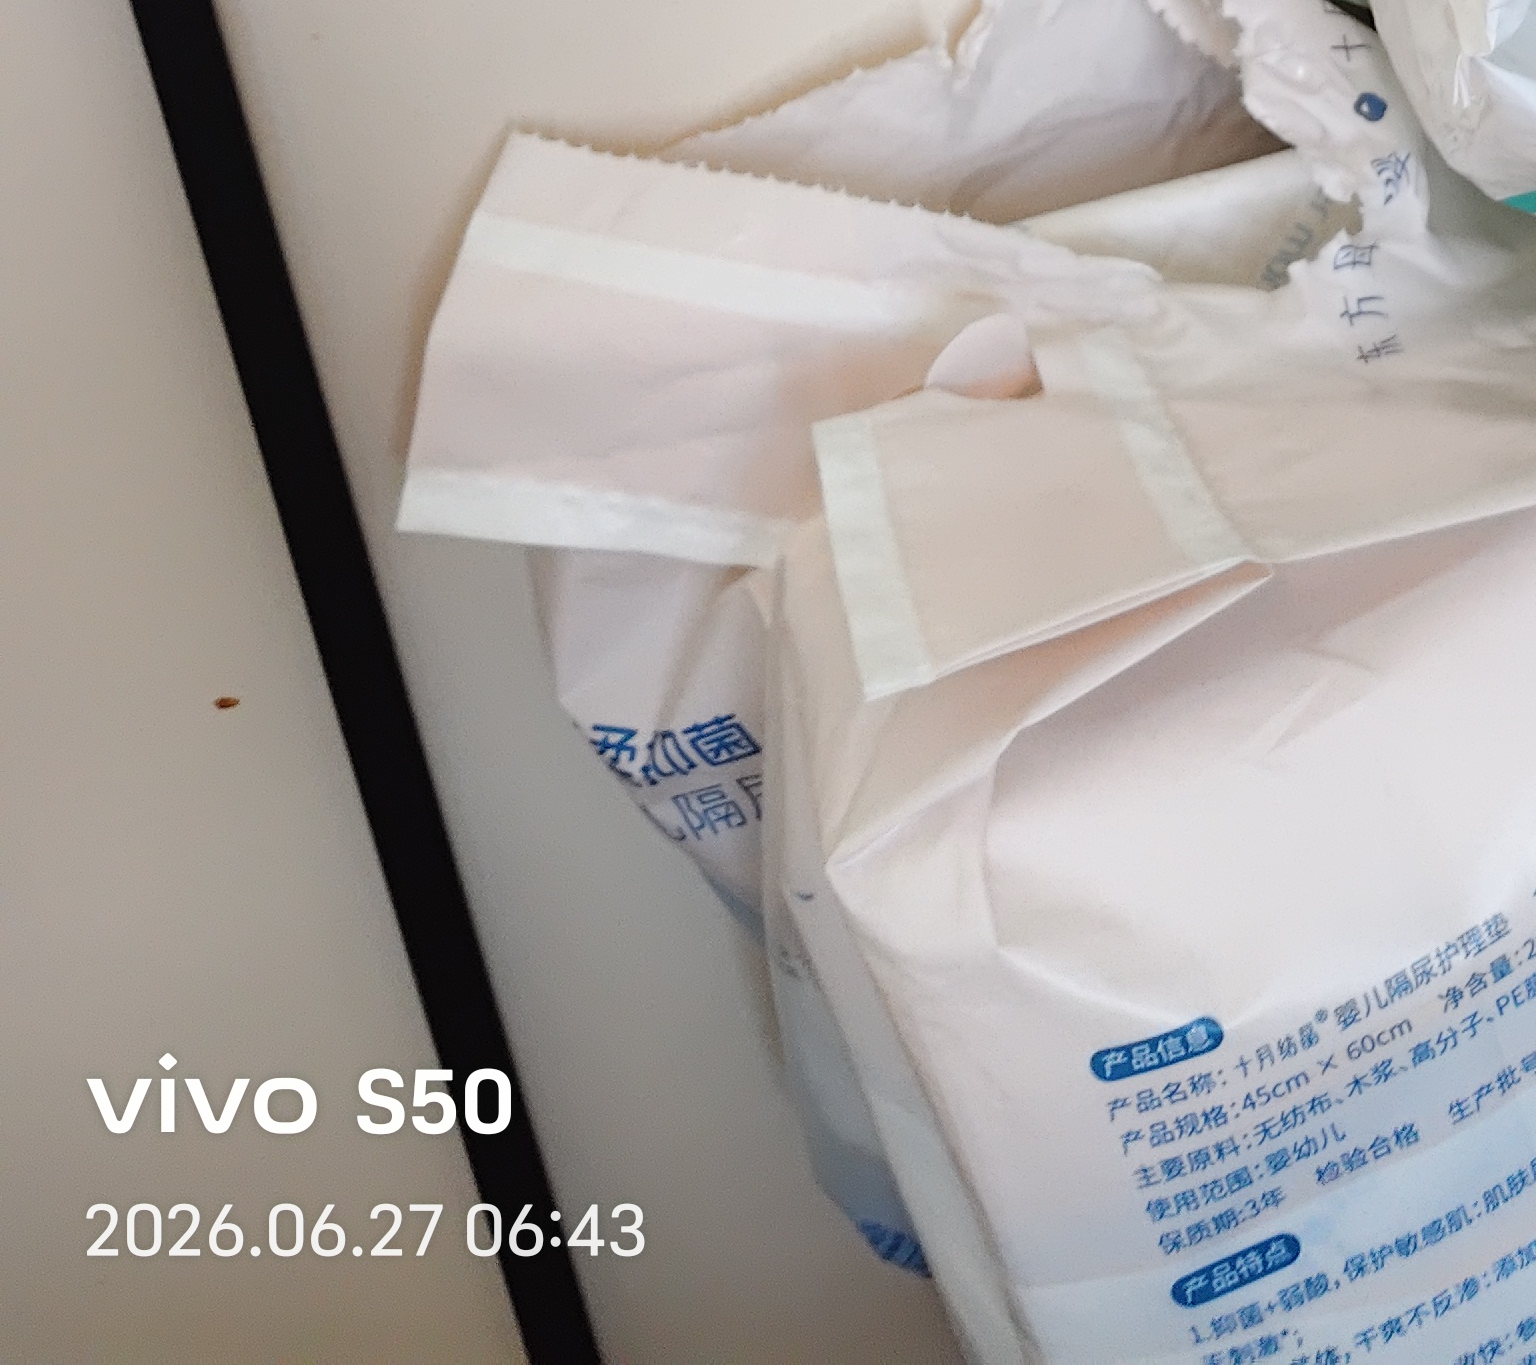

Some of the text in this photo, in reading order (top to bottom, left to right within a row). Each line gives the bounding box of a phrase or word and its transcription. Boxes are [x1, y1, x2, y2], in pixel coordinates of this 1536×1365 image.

[1101, 1023, 1213, 1077] 产品信息
[1345, 1017, 1413, 1062] 60cm
[1145, 1121, 1346, 1223] 使用范围：婴幼儿
[1314, 1121, 1422, 1186] 检验合格
[1182, 1237, 1289, 1305] 产品特点
